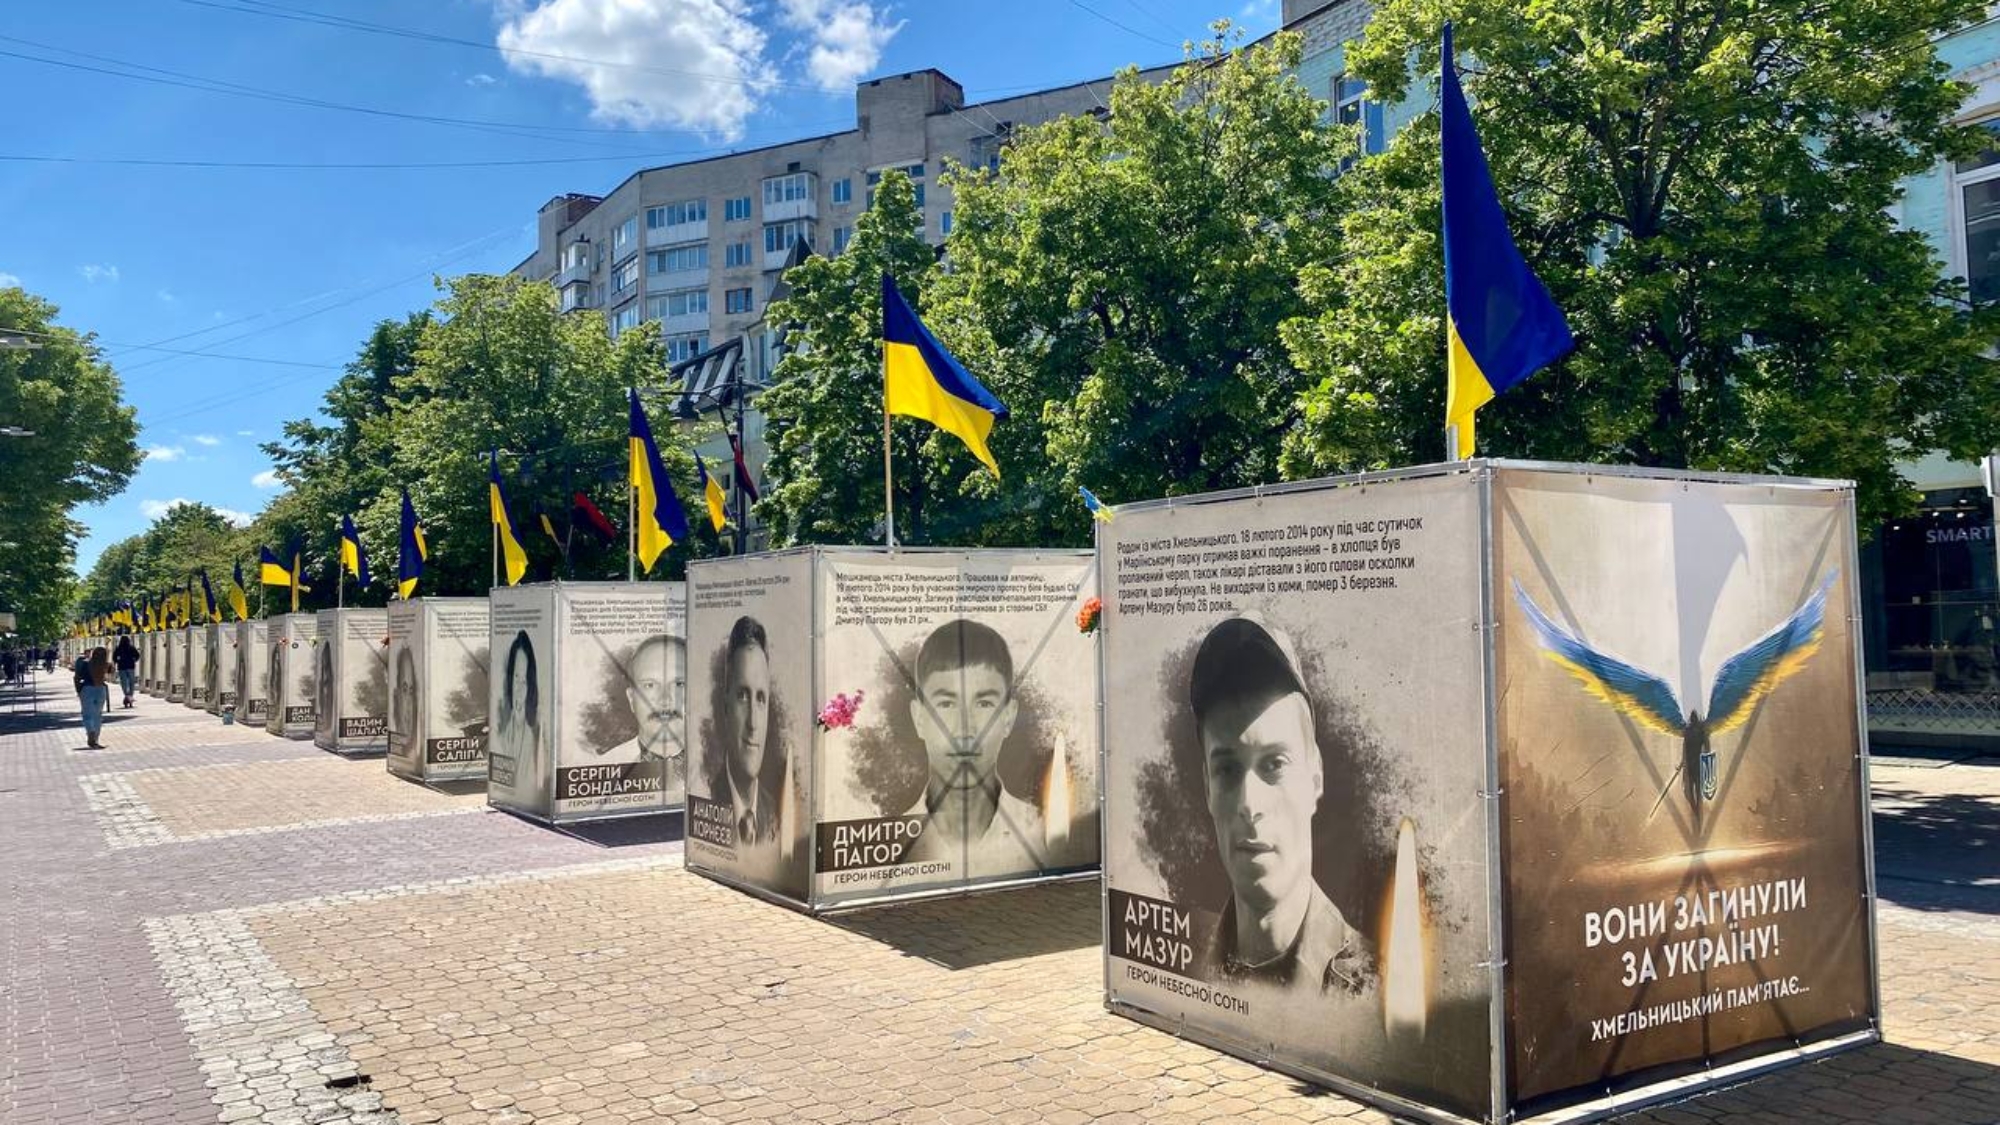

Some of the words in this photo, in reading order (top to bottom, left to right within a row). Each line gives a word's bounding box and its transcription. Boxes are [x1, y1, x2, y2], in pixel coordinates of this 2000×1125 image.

[1117, 542, 1141, 554] Родом
[1141, 540, 1149, 552] із
[1150, 537, 1171, 550] міста
[1173, 532, 1239, 550] Хмельницького.
[1240, 530, 1250, 542] 18
[1252, 528, 1285, 543] лютого
[1286, 525, 1308, 540] 2014
[1310, 525, 1335, 541] року
[1337, 520, 1353, 536] під
[1355, 520, 1374, 533] час
[1377, 517, 1423, 535] сутичок
[1926, 525, 1992, 543] SMART
[1118, 559, 1123, 571] у
[1176, 552, 1200, 567] парку
[1202, 549, 1238, 565] отримав
[1240, 545, 1267, 559] важкі
[1268, 543, 1321, 560] поранення
[1331, 542, 1338, 554] в
[1340, 539, 1379, 554] хлопця
[1381, 536, 1401, 554] був
[1118, 568, 1164, 585] проламаний
[1165, 569, 1191, 586] череп,
[1193, 567, 1218, 579] також
[1220, 562, 1246, 579] лікарі
[1248, 562, 1294, 578] діставали
[1304, 559, 1327, 575] його
[1329, 558, 1365, 573] голови
[1368, 555, 1415, 571] осколки
[892, 584, 910, 594] року
[912, 583, 924, 594] був
[1118, 587, 1149, 602] гранати,
[1151, 585, 1163, 599] що
[1164, 583, 1208, 602] вибухнула.
[1210, 582, 1221, 595] Не
[1224, 580, 1265, 596] виходячи
[1267, 578, 1276, 593] із
[1278, 579, 1304, 594] коми,
[1306, 577, 1338, 594] помер
[1340, 575, 1347, 590] 3
[1349, 575, 1398, 593] березня.
[1118, 600, 1145, 616] Артему
[1146, 600, 1175, 616] Мазуру
[1176, 599, 1196, 614] було
[346, 718, 382, 728] ВАДИМ
[437, 736, 479, 751] СЕРГІЙ
[437, 750, 484, 762] САЛІПА
[568, 765, 621, 782] СЕРГІЙ
[568, 777, 661, 797] БОНДАРЧУК
[833, 819, 922, 849] ДМИТРО
[833, 843, 903, 868] ПАГОР
[869, 865, 920, 880] НЕБЕСНОЇ
[921, 862, 951, 875] СОТНІ
[1125, 898, 1190, 939] АРТЕМ
[1585, 900, 1667, 948] ВОНИ
[1674, 876, 1806, 931] ЗАГИНУЛИ
[1126, 928, 1193, 971] МАЗУР
[1621, 947, 1658, 987] ЗА
[1664, 922, 1780, 978] УКРАЇНУ!
[1127, 965, 1157, 986] ГЕРОЙ
[1160, 975, 1212, 1003] НЕБЕСНОЇ
[1213, 992, 1249, 1015] СОТНІ
[1591, 986, 1723, 1042] ХМЕЛЬНИЦЬКИЙ
